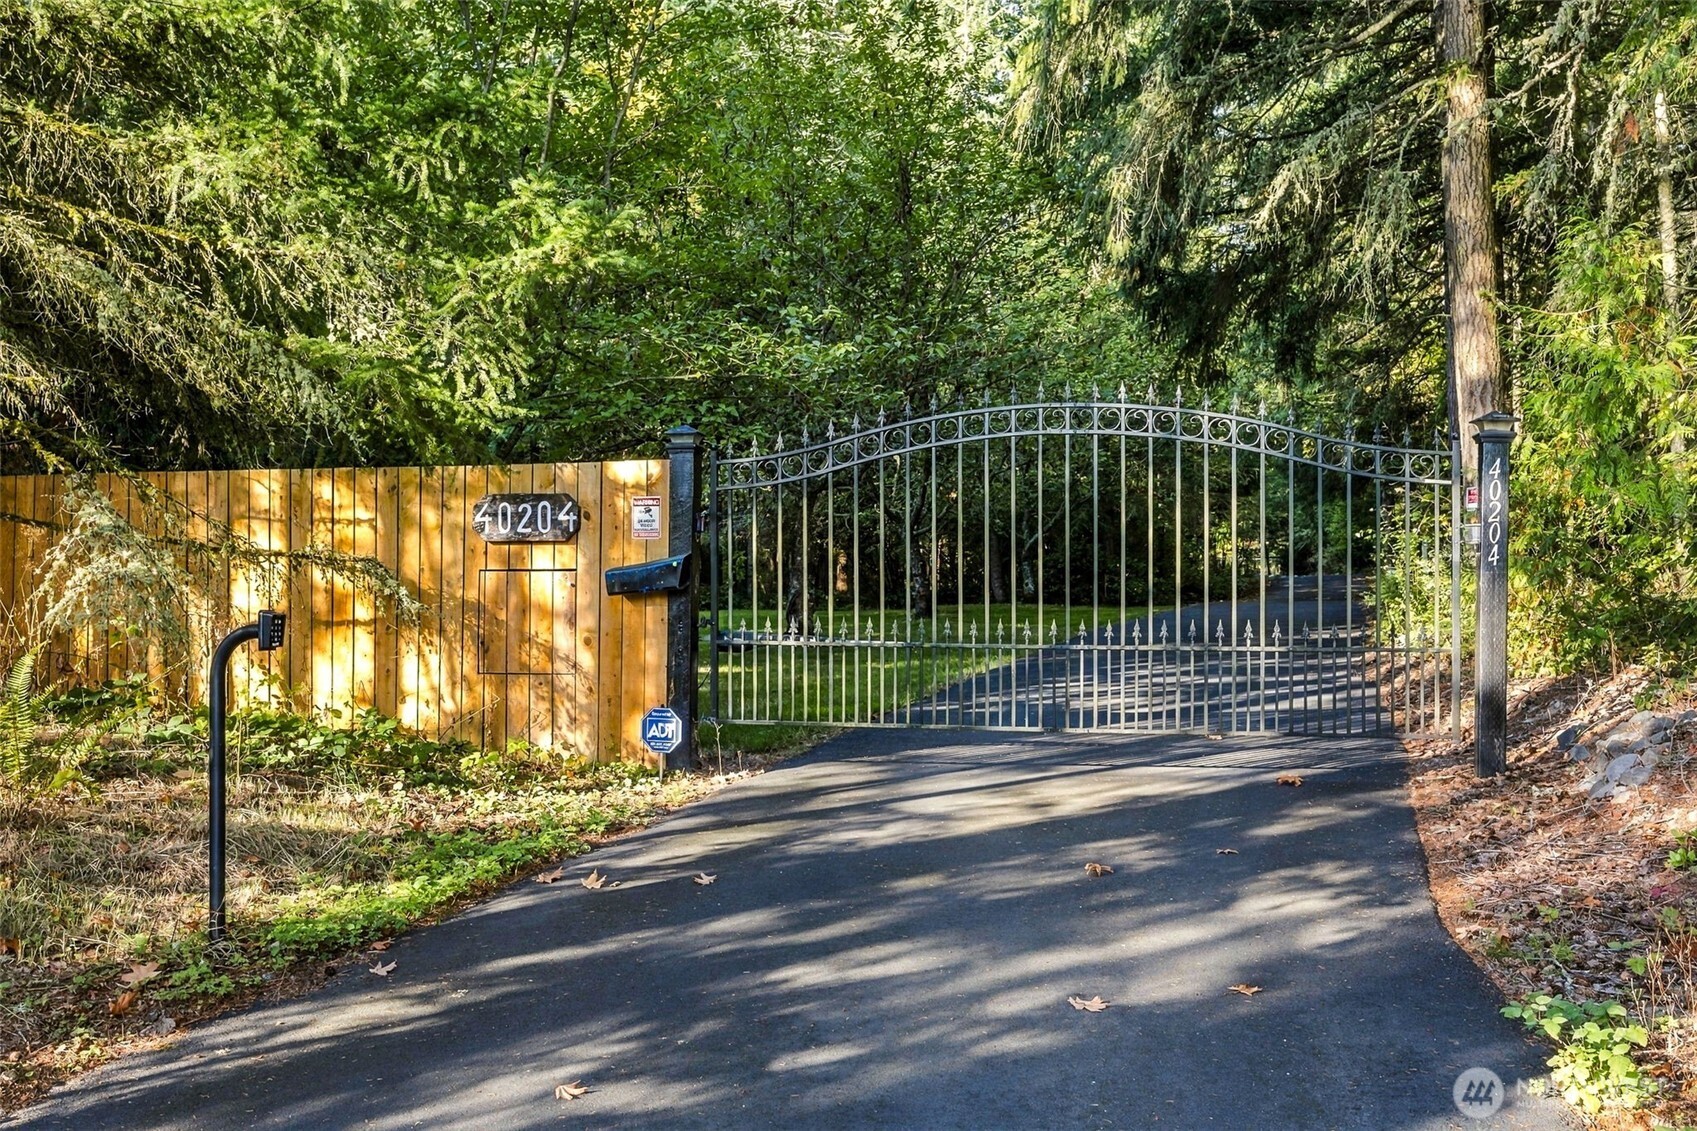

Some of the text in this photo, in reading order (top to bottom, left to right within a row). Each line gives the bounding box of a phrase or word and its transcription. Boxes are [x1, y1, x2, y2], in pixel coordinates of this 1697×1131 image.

[474, 500, 577, 534] 40204
[1488, 457, 1501, 566] 40204
[647, 722, 674, 738] ADT
